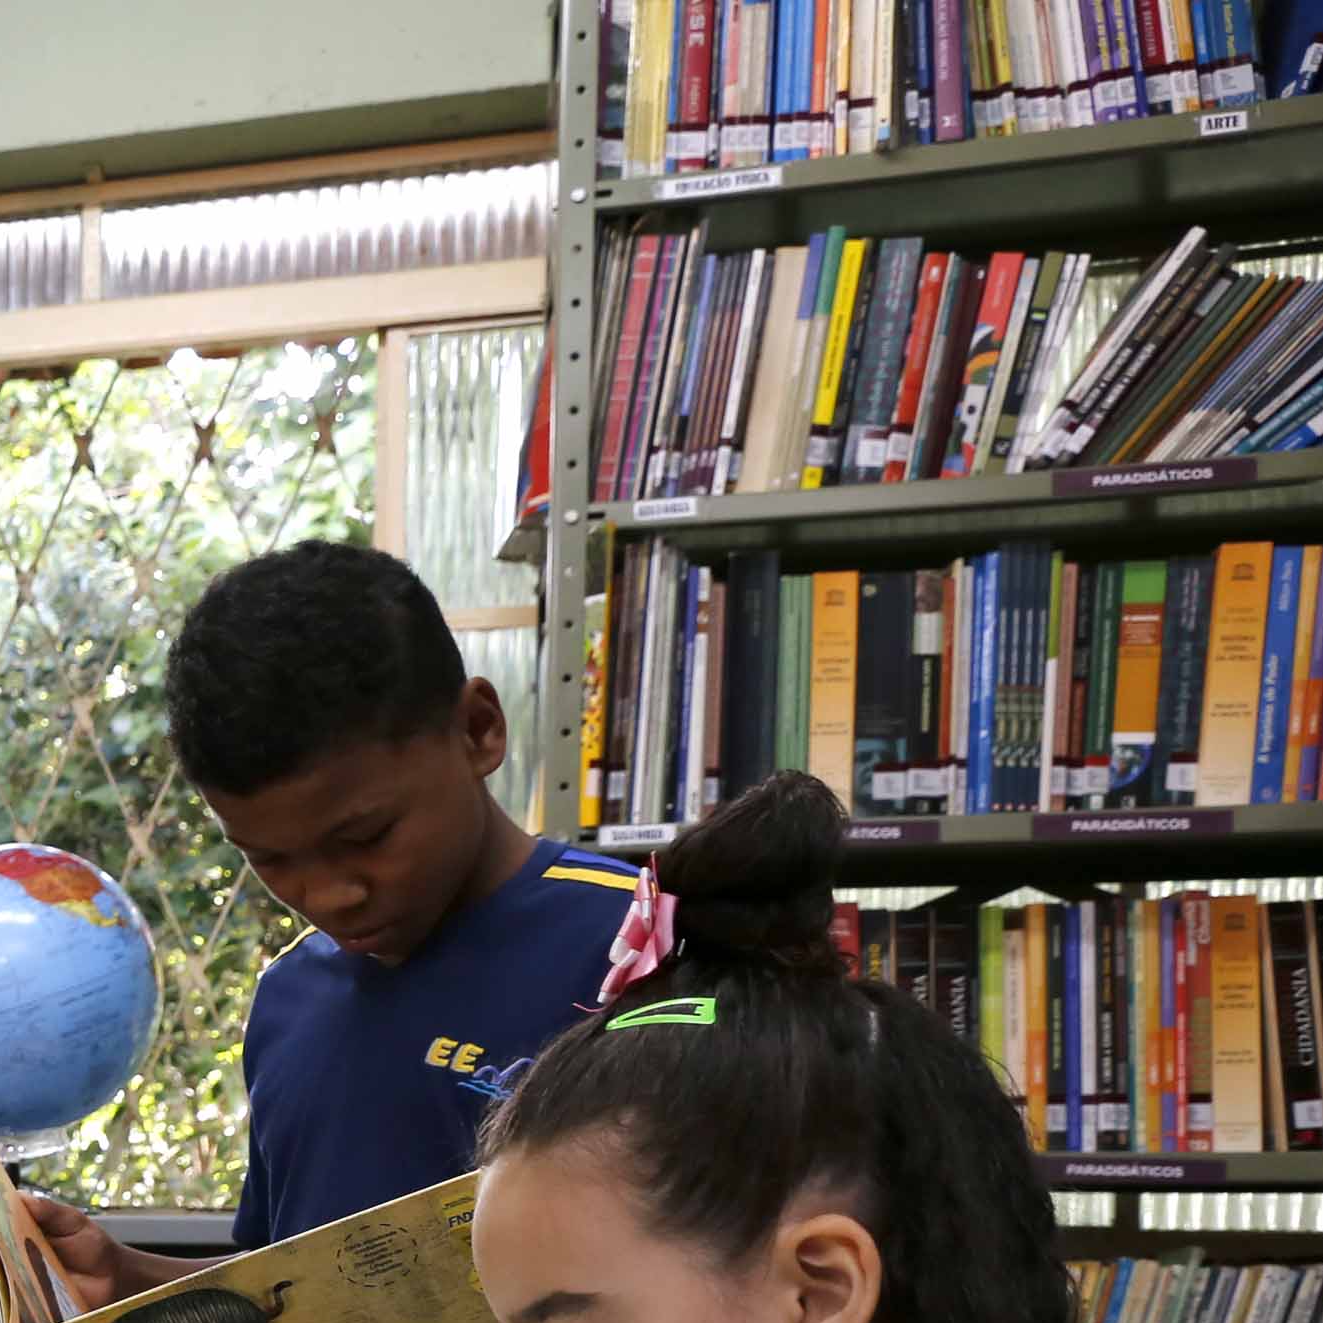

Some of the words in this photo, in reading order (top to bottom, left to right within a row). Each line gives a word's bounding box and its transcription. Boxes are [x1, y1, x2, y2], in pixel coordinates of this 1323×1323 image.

[1206, 114, 1239, 130] ARTE
[1092, 467, 1214, 488] PARADIDÁTICOS
[1071, 816, 1191, 832] PARADIDÁTICOS
[1291, 967, 1315, 1067] CIDADANIA
[424, 1036, 485, 1073] EE
[1065, 1161, 1185, 1179] PARADIDÁTICOS
[448, 1209, 475, 1229] FND
